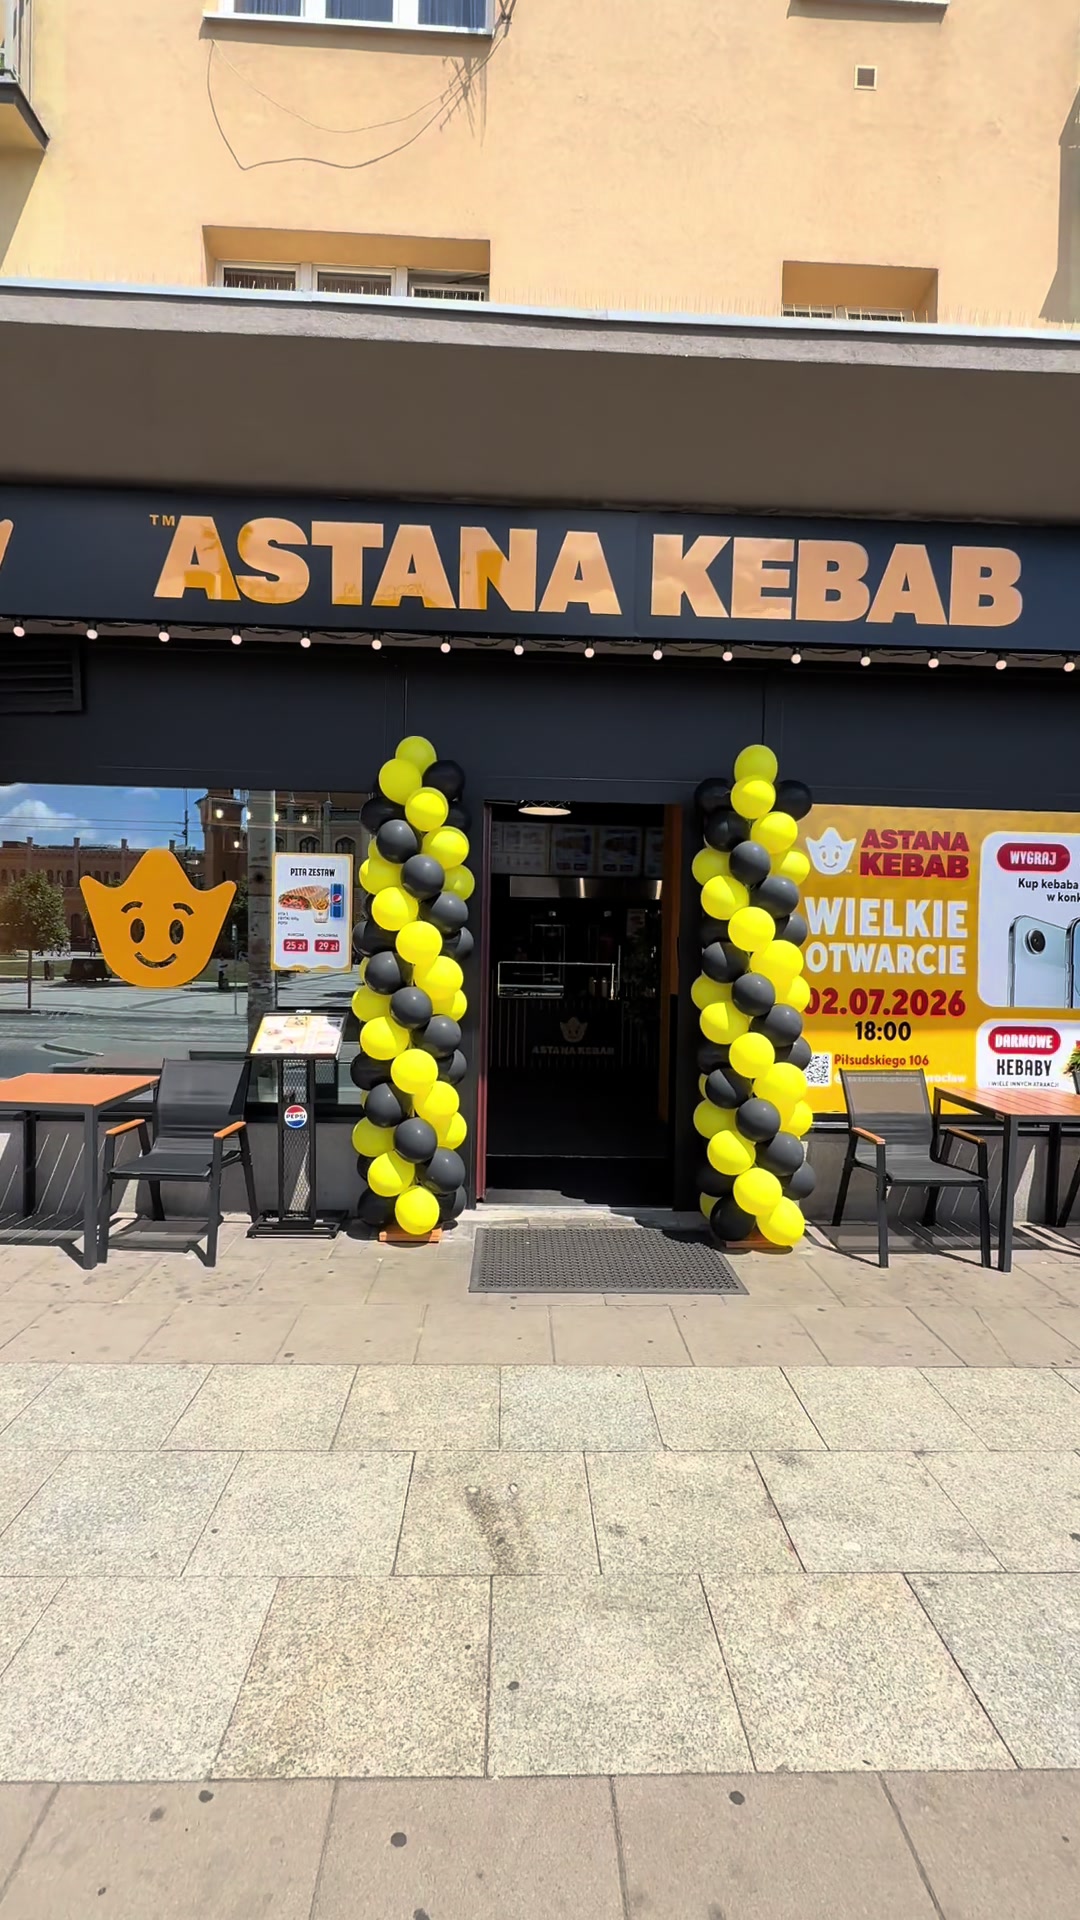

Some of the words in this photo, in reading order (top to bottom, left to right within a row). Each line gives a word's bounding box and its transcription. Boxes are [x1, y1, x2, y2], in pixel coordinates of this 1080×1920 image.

[154, 514, 622, 616] ASTANA
[650, 533, 1023, 627] KEBAB
[861, 828, 969, 852] ASTANA
[859, 851, 970, 879] KEBAB
[1009, 850, 1057, 866] WYGRAJ
[290, 867, 307, 877] PITA
[308, 868, 336, 877] ZESTAW
[1018, 877, 1039, 891] Kup
[1041, 878, 1079, 890] kebaba
[1047, 893, 1056, 902] w
[804, 896, 968, 939] WIELKIE
[286, 941, 297, 950] 25
[297, 941, 306, 950] zł
[319, 942, 329, 950] 29
[330, 942, 339, 951] zł
[805, 941, 967, 975] OTWARCIE
[855, 1020, 912, 1041] 18:00
[995, 1034, 1054, 1049] DARMOWE
[834, 1054, 906, 1068] Piłsudskiego
[909, 1055, 929, 1066] 106
[996, 1059, 1052, 1076] KEBABY
